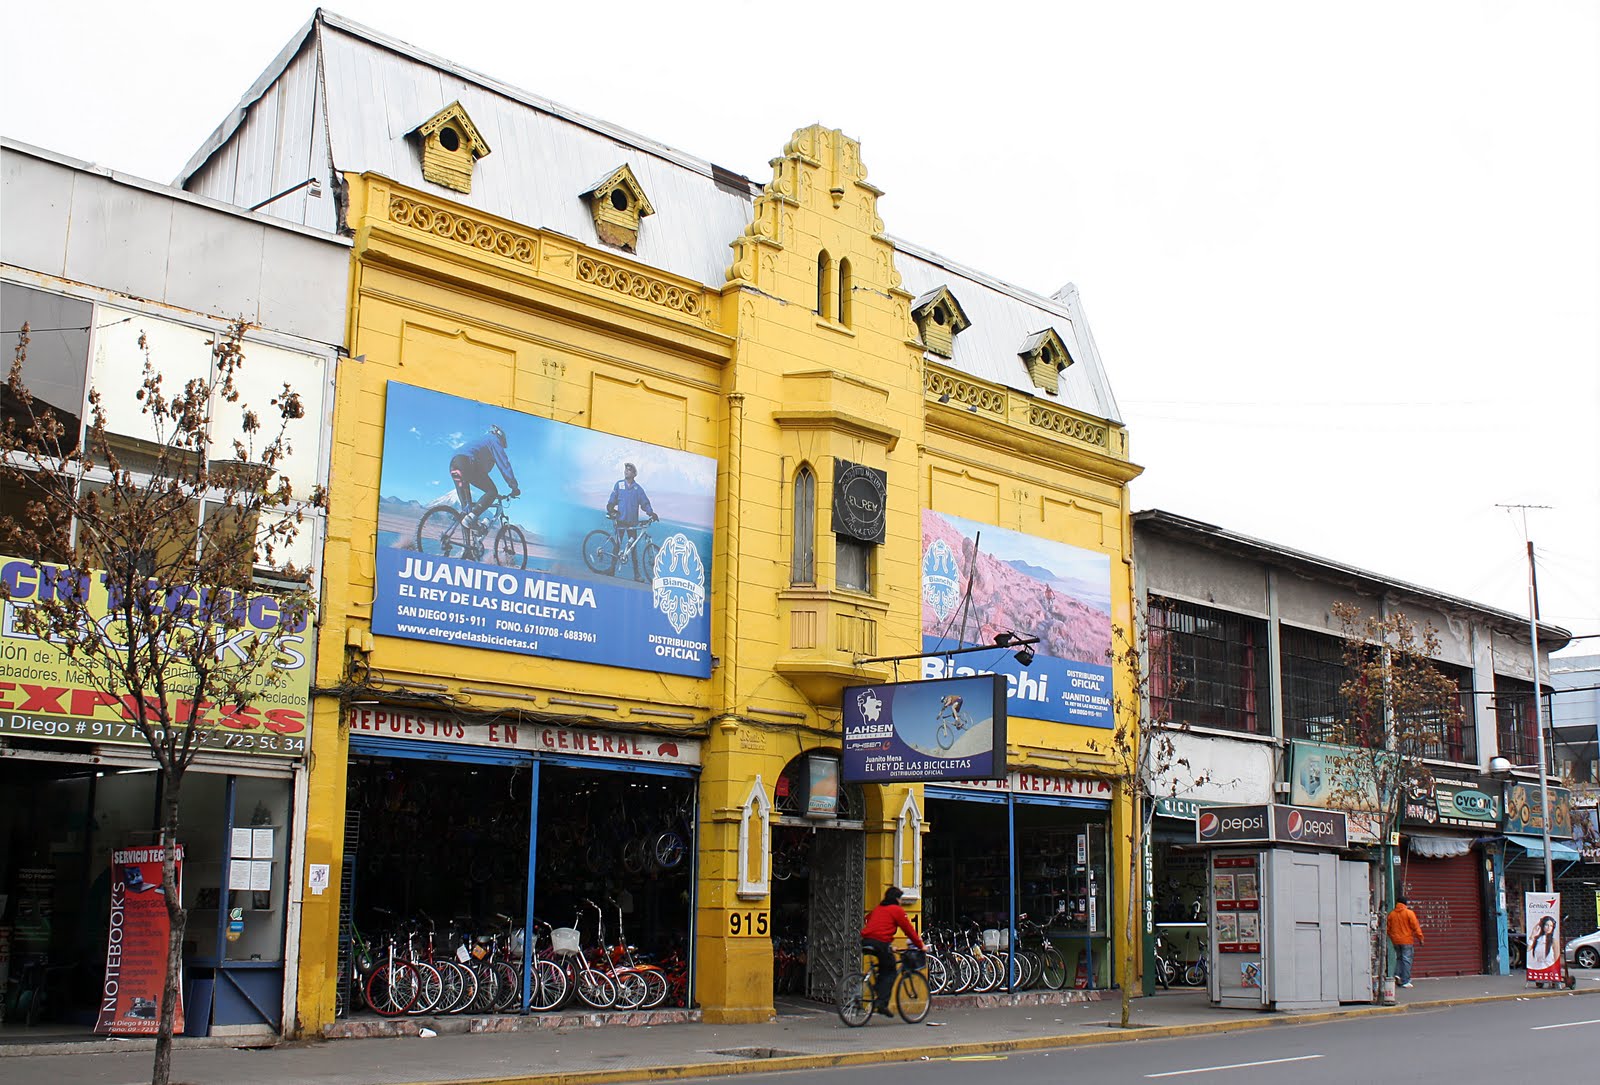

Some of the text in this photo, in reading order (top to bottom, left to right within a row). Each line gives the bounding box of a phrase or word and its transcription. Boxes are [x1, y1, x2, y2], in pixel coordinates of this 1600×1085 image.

[398, 557, 597, 609] JUANITO MENA
[662, 577, 696, 592] Bianchi
[928, 577, 953, 587] Bianchi
[399, 584, 576, 622] EL REY DE LAS BICICLETAS
[397, 605, 417, 617] SAN
[418, 608, 448, 621] DIEGO
[495, 619, 523, 633] FONO.
[397, 623, 538, 650] www.elreydelasbicicletas.cl
[648, 634, 708, 651] DISTRIBUIDOR
[33, 650, 54, 664] de:
[655, 645, 701, 662] OFICIAL
[921, 656, 1048, 703] Biachi
[1066, 669, 1105, 683] DISTRIBUIDOR
[1071, 680, 1101, 692] OFICIAL
[1061, 691, 1111, 707] JUANITO MENA
[11, 714, 70, 735] Diego
[75, 720, 86, 734] #
[92, 722, 126, 738] 917
[132, 725, 182, 743] Fn:
[284, 738, 305, 752] 34
[350, 708, 465, 739] REPUESTOS
[488, 723, 518, 744] EN
[845, 723, 894, 735] LAHSEN
[865, 755, 886, 763] Juanito
[865, 759, 971, 772] EL REY DE LAS BICICLETAS
[1019, 773, 1093, 795] REPARTO
[1164, 800, 1198, 815] BICIC
[1221, 814, 1263, 833] pepsi
[1304, 819, 1334, 837] pepsi
[114, 849, 148, 864] SERVICIO
[729, 912, 768, 936] 915
[102, 881, 126, 1012] NOTEBOOK'S
[117, 1020, 137, 1028] Diego
